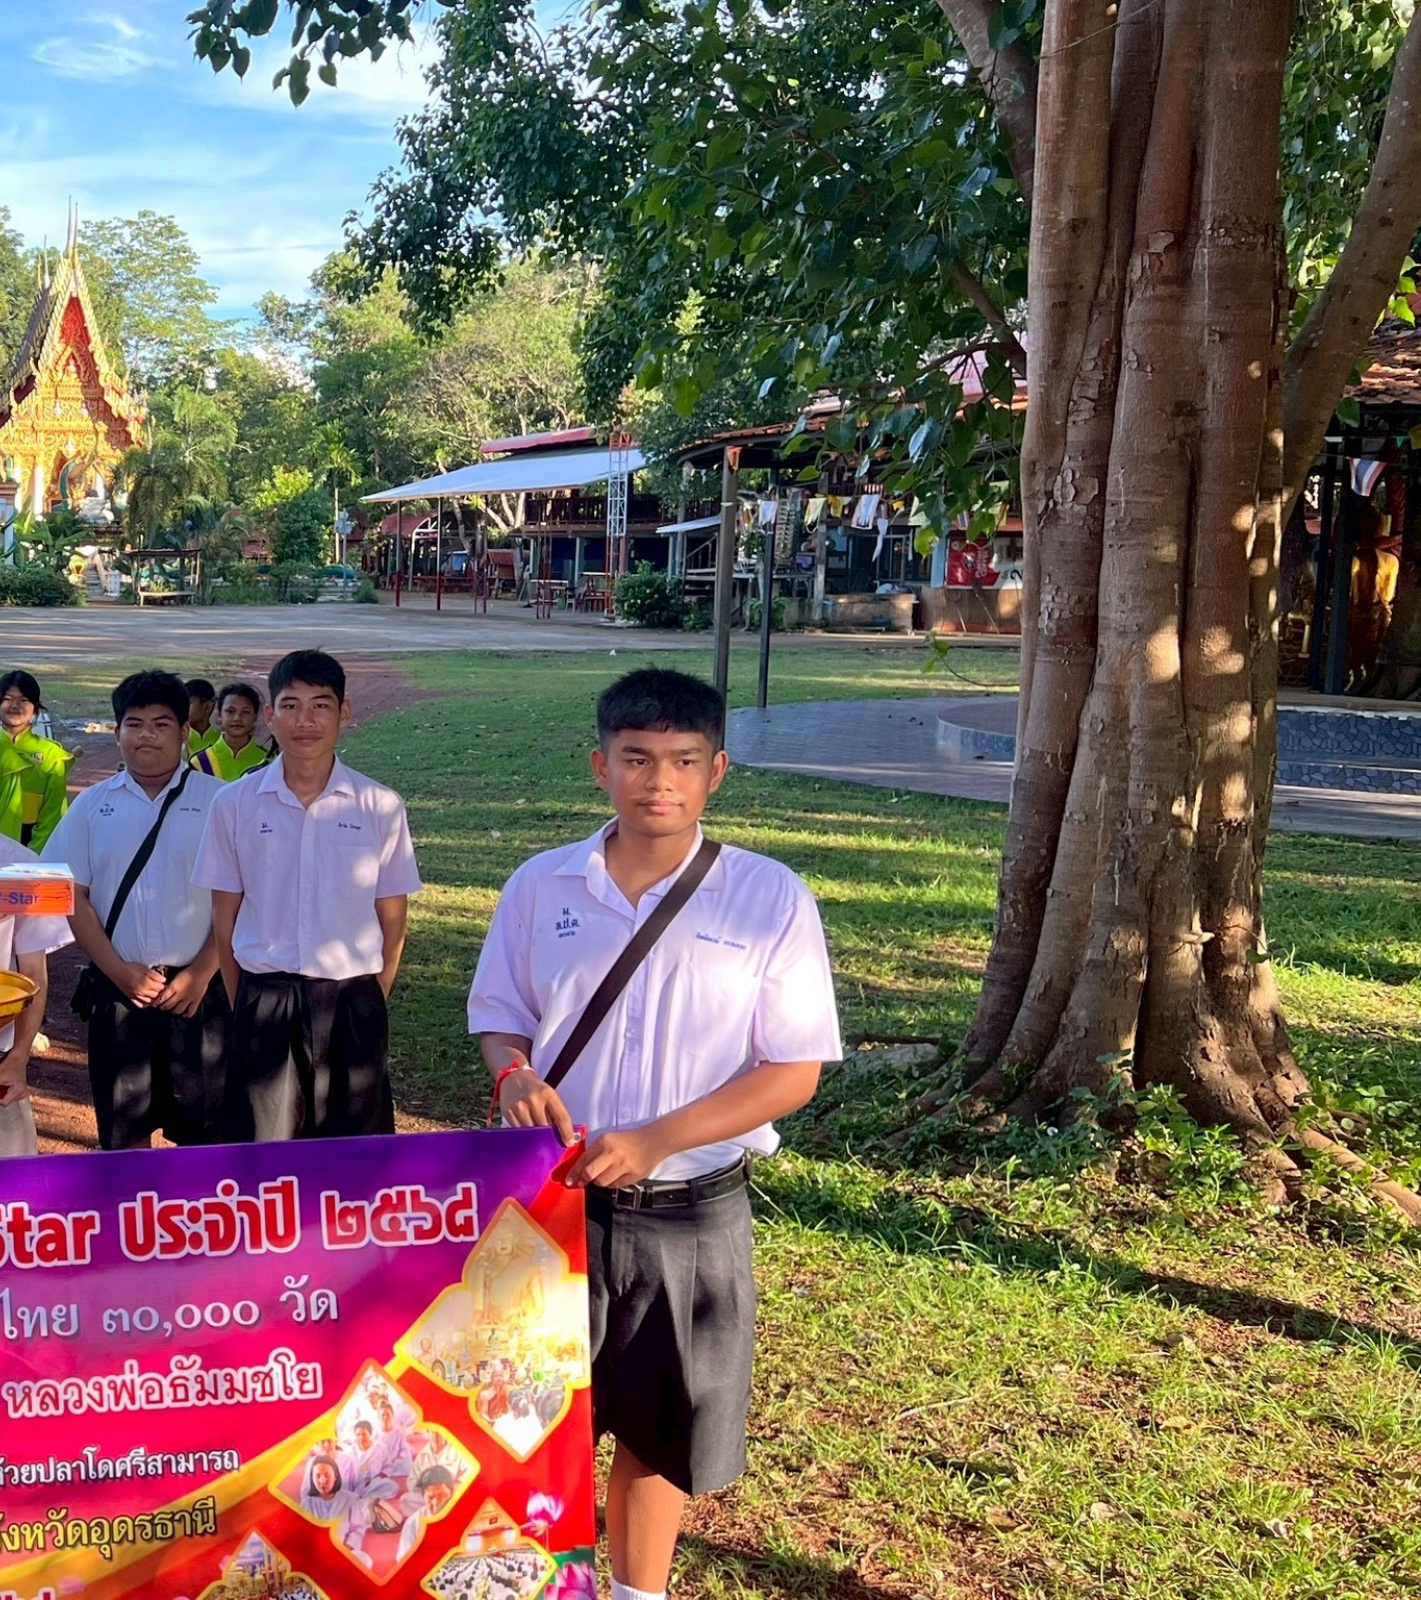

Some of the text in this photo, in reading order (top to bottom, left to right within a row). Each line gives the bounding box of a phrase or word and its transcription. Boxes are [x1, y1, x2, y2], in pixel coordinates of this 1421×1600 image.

[119, 1176, 300, 1261] ประจำปี
[320, 1182, 479, 1249] ๒๕๖๘
[279, 1274, 338, 1323] วัด
[2, 1347, 322, 1419] หลวงพ่อธัมมชโย
